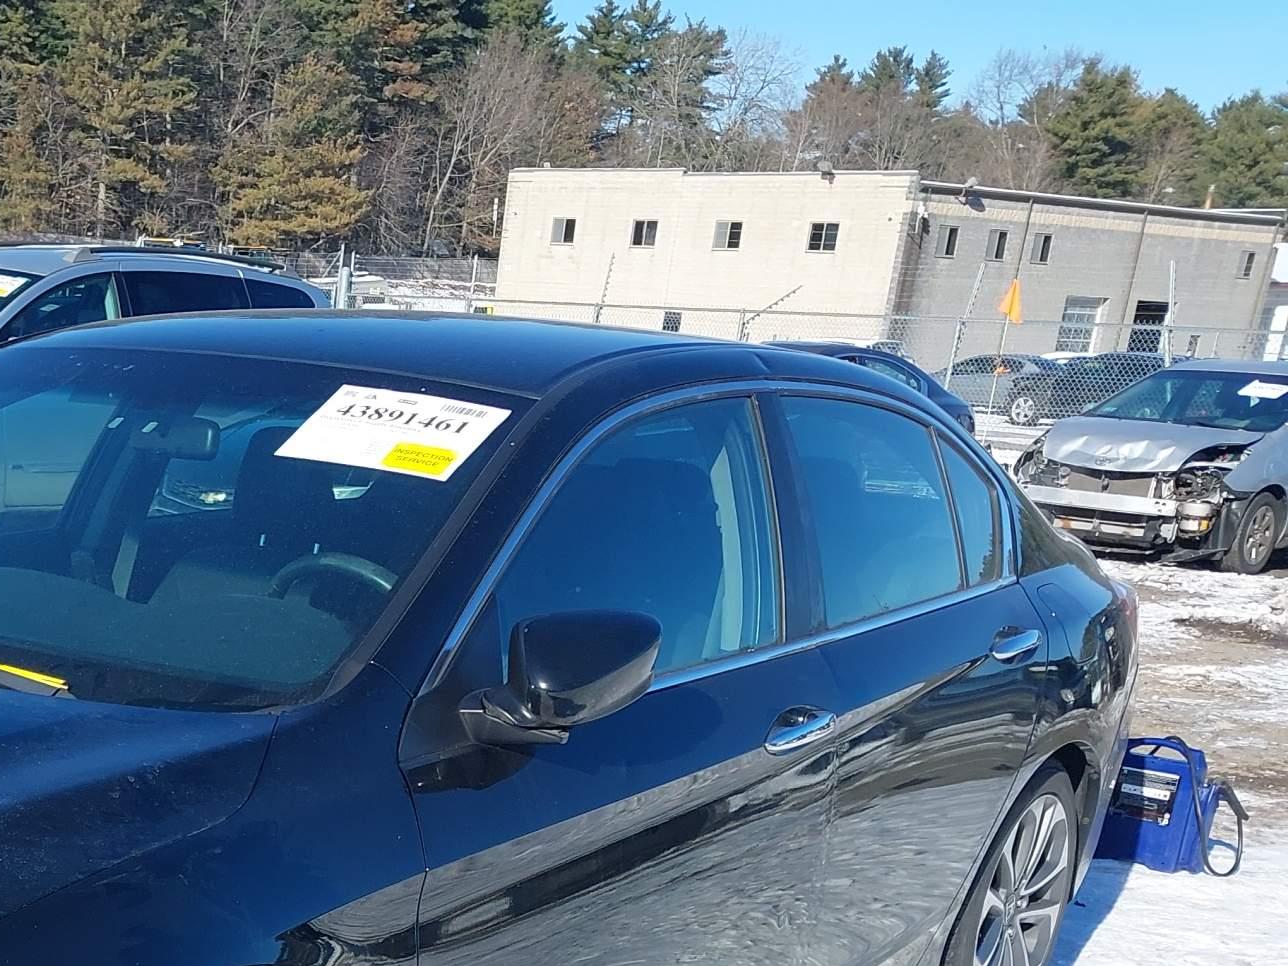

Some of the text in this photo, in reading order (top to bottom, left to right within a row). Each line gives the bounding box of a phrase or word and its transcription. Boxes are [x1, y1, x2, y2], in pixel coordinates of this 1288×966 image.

[336, 403, 470, 434] 43891461
[393, 448, 454, 462] INSPECTION
[395, 455, 440, 467] SERVICE
